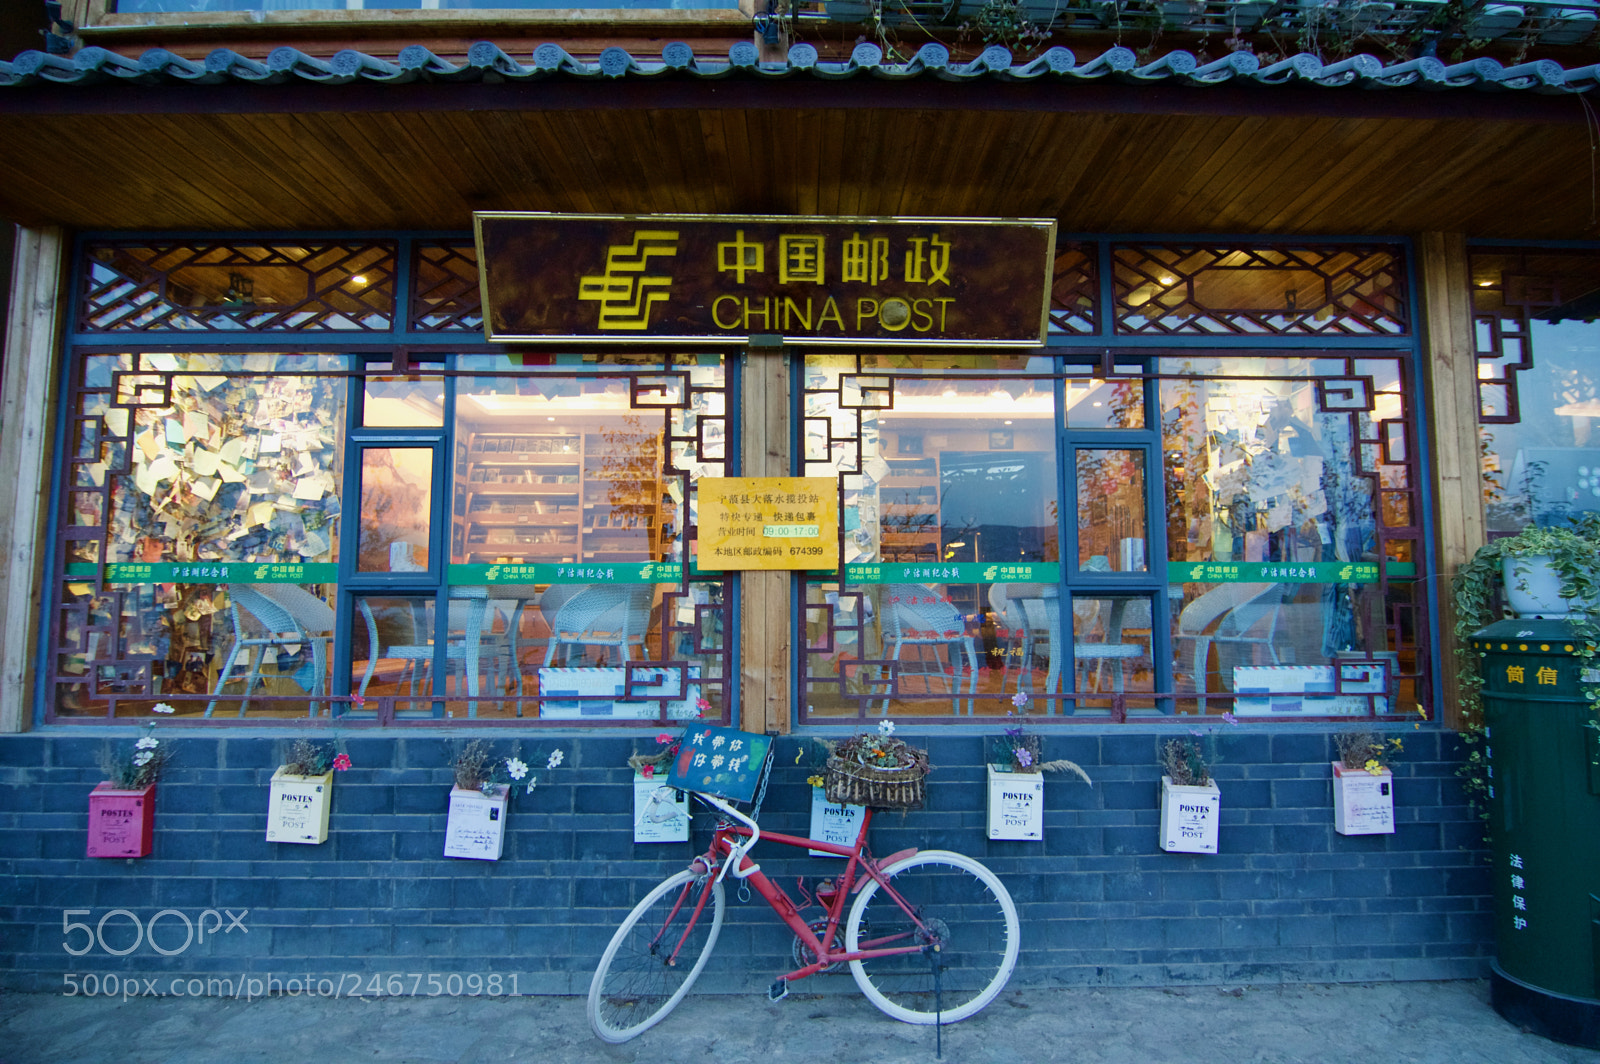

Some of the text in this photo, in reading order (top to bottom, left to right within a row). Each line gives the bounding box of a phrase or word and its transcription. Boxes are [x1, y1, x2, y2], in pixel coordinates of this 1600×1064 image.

[716, 230, 953, 286] 中国邮政
[712, 295, 956, 332] CHINA POST
[720, 512, 816, 522] 特快专递 快递包裹
[718, 526, 756, 537] 营业时间
[714, 546, 824, 557] 本地区邮政编码 674399
[991, 648, 1024, 657] 祝福
[692, 732, 744, 751] 我带你
[281, 794, 313, 803] POSTES
[1003, 792, 1033, 801] POSTES
[824, 808, 855, 817] POSTES
[1180, 804, 1210, 813] POSTES
[1510, 854, 1528, 930] 法律保护
